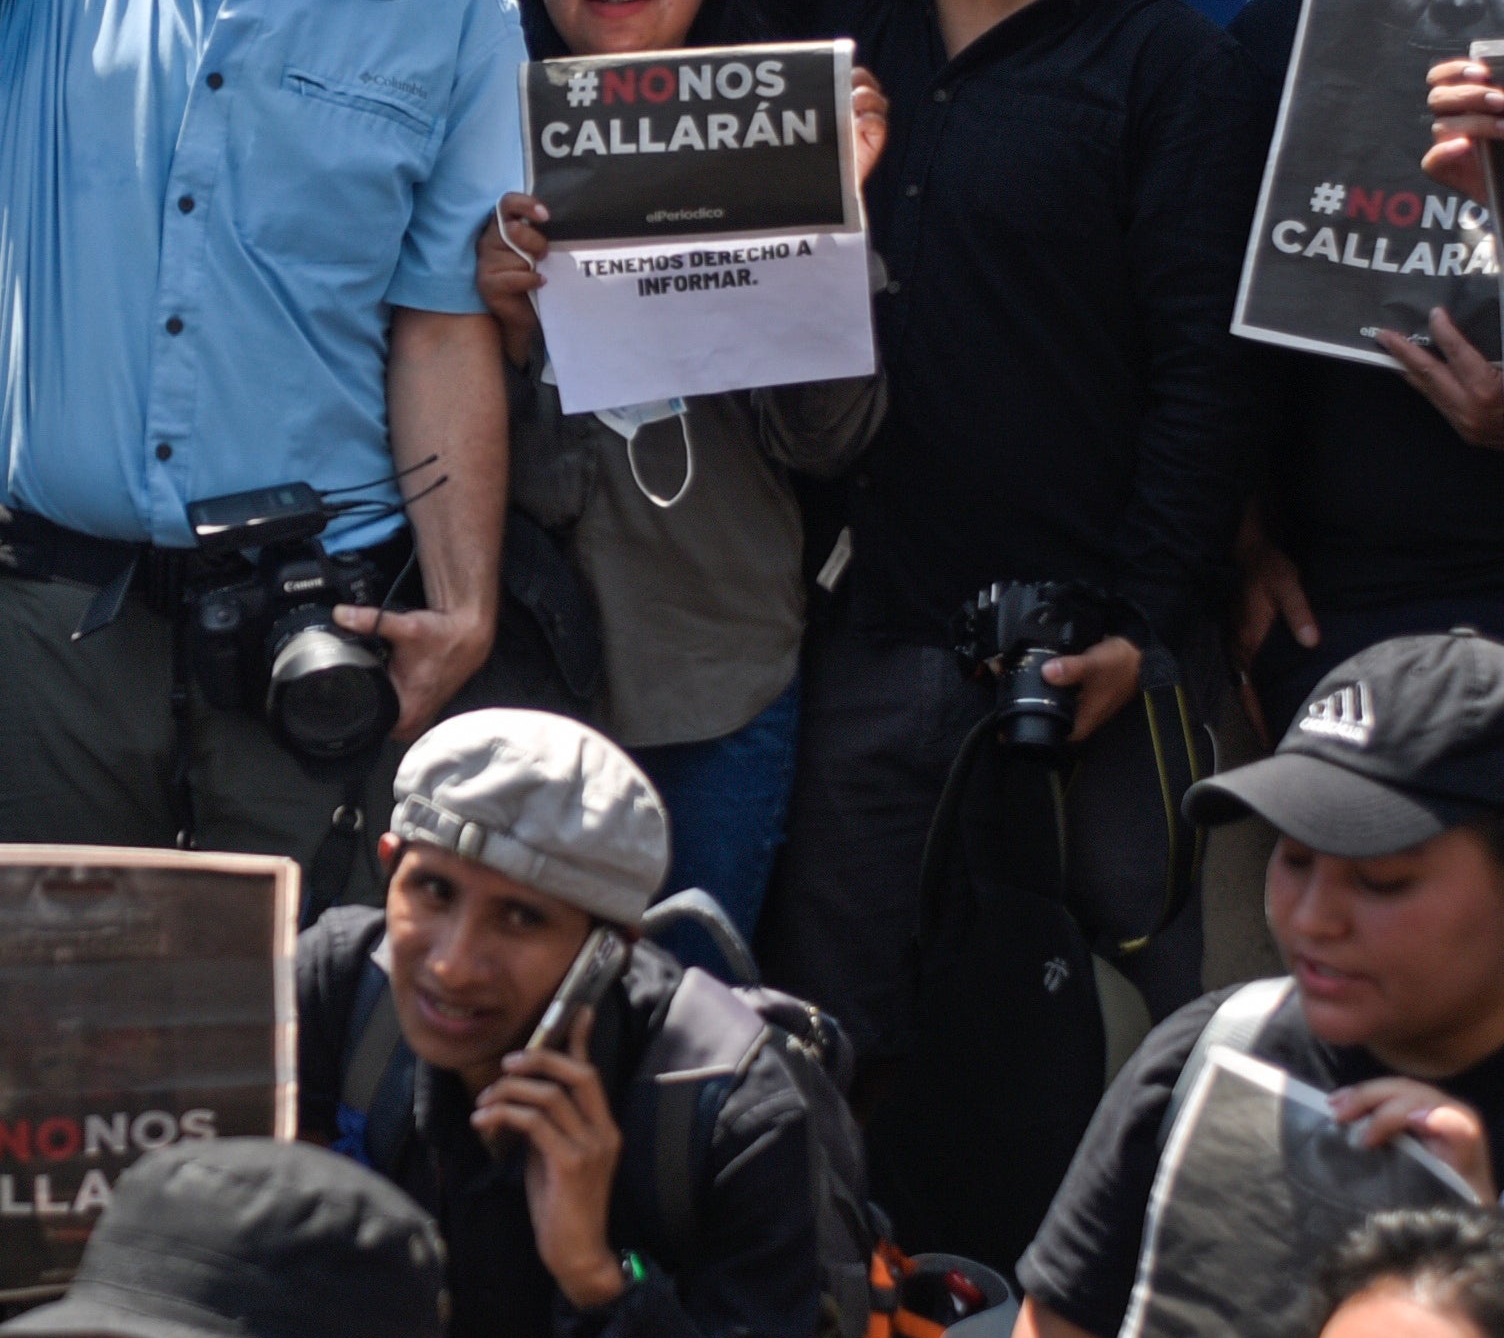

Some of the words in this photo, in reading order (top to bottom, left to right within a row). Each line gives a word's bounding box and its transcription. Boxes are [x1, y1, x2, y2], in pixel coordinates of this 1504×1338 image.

[567, 60, 785, 108] #NONOS
[540, 103, 818, 158] CALLARÁN
[646, 206, 723, 224] elPeriodico
[1309, 182, 1492, 231] #NONO
[582, 252, 683, 278] TENEMOS
[690, 243, 791, 267] DERECHO
[797, 239, 812, 258] A
[1271, 220, 1500, 277] CALLARÁ
[638, 268, 759, 297] INFORMAR.
